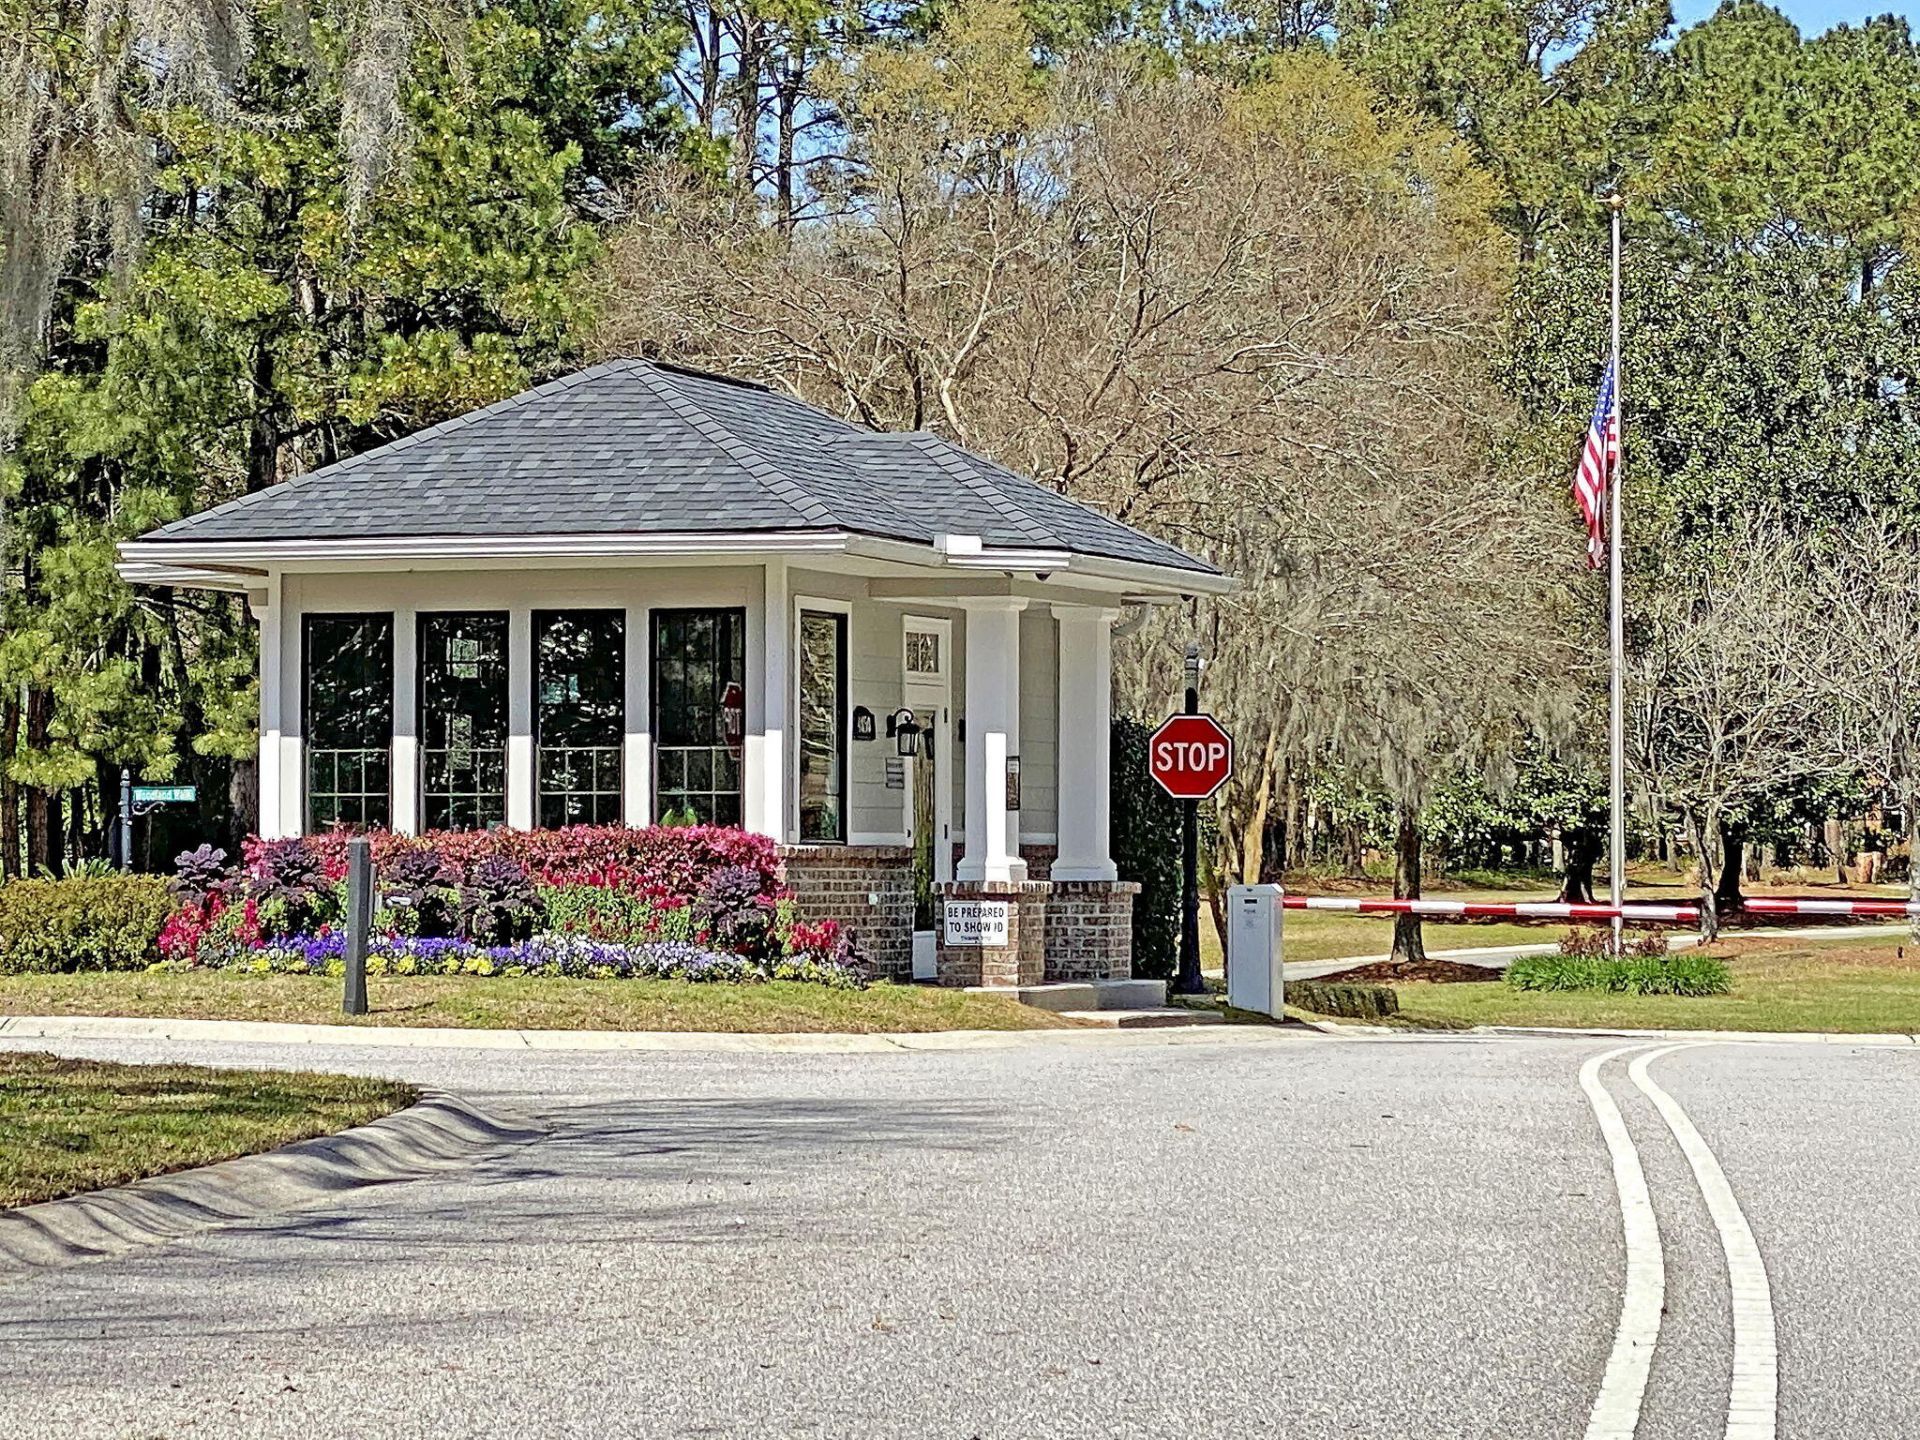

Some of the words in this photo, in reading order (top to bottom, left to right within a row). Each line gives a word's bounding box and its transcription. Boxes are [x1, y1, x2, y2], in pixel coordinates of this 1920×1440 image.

[1156, 742, 1225, 771] STOP
[948, 907, 958, 918] BE
[962, 907, 1003, 918] PREPARED
[949, 922, 961, 933] TO
[964, 922, 991, 933] SHOW
[994, 922, 1003, 933] ID
